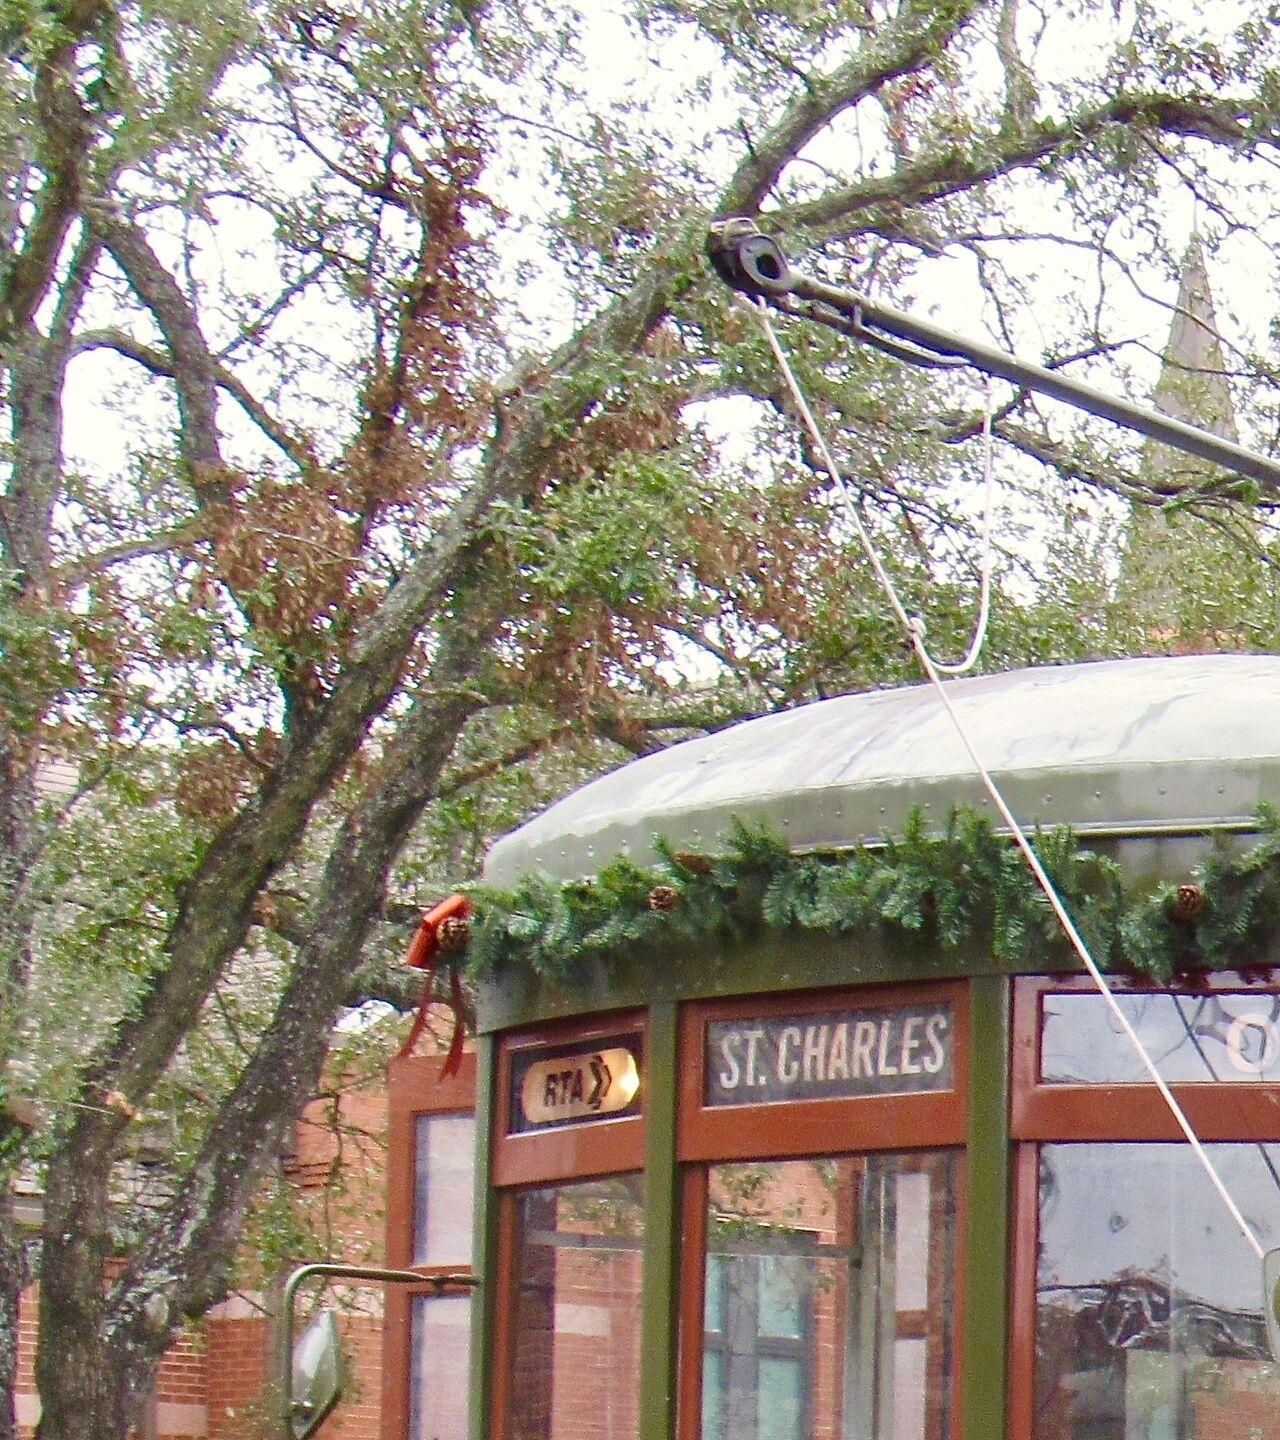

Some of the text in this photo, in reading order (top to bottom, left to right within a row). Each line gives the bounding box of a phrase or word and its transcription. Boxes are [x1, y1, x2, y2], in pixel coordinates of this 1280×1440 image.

[720, 1014, 948, 1090] ST. CHARLES
[542, 1070, 583, 1109] RTA
